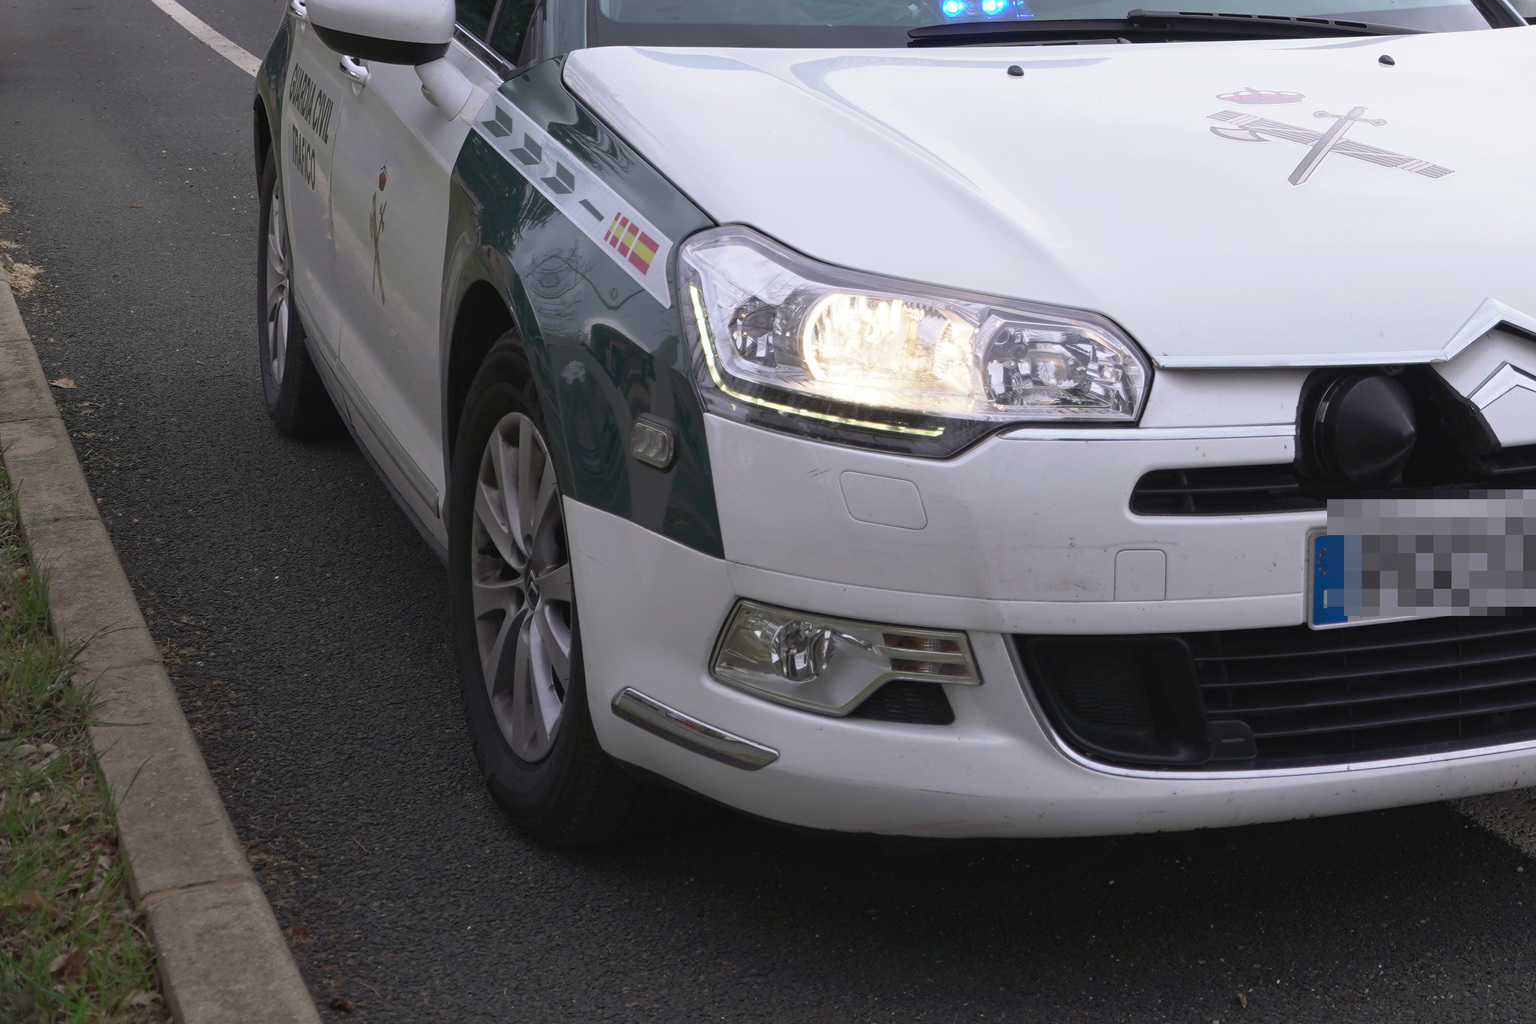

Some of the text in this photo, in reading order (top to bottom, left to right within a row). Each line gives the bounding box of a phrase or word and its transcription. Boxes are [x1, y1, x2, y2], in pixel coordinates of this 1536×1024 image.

[289, 62, 334, 145] GUARDIA CIVIL
[292, 123, 316, 191] TRAFICO
